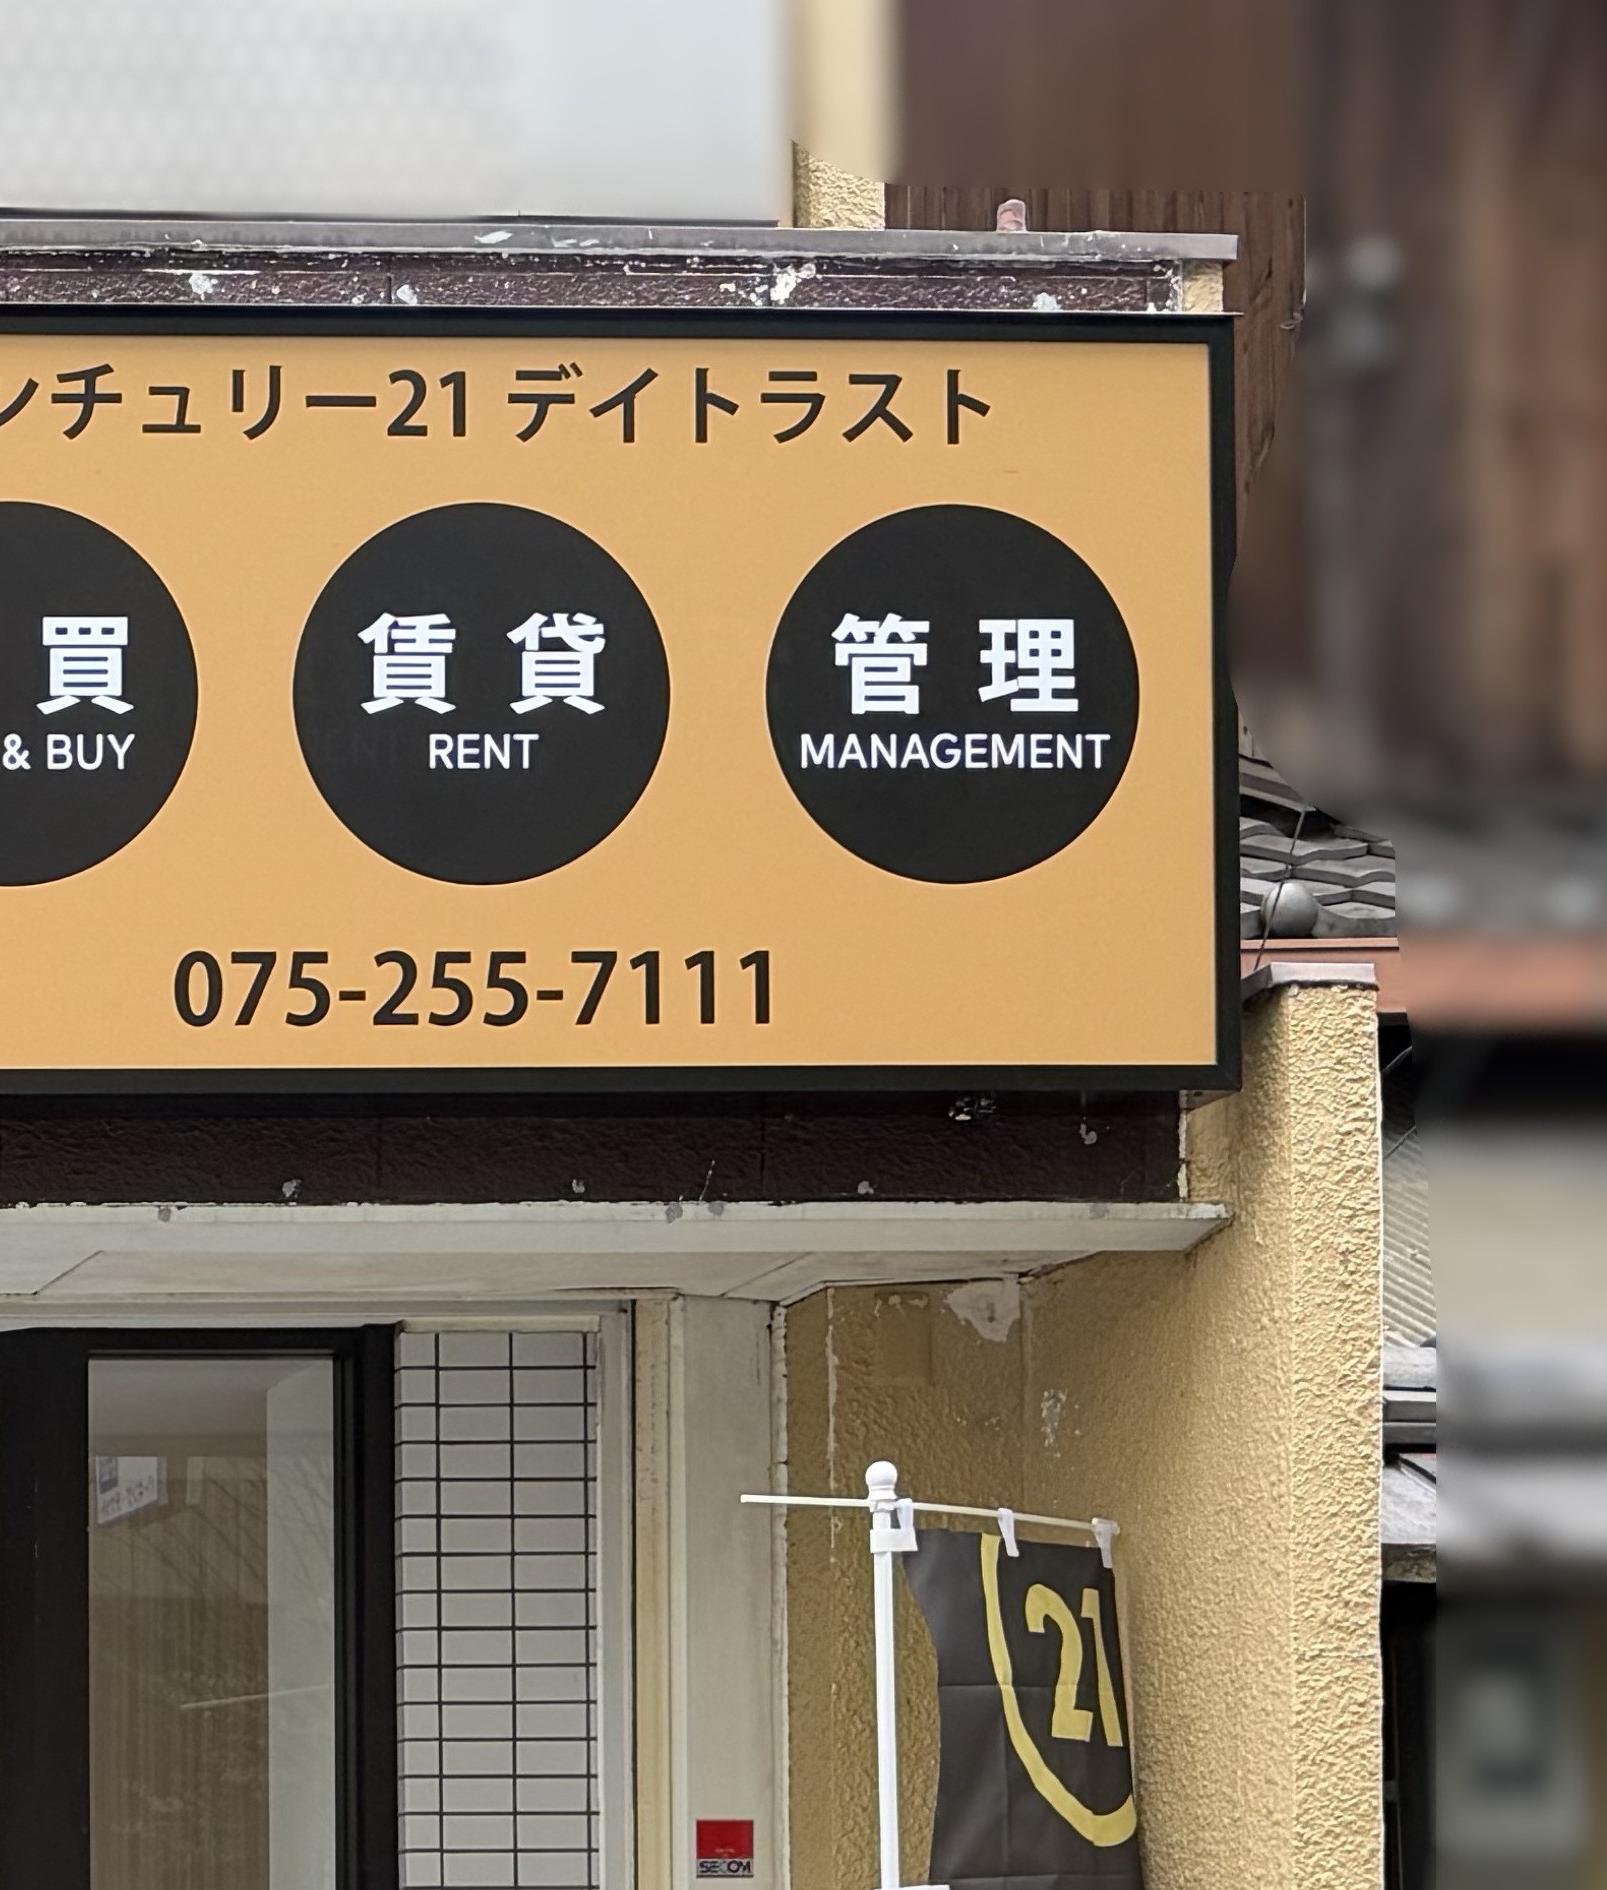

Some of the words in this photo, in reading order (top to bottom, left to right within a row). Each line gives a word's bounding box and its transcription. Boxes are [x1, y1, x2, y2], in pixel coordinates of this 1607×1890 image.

[508, 363, 992, 446] デイトラスト
[358, 613, 607, 716] 賃貸
[832, 613, 1080, 716] 管理
[3, 734, 32, 772] &
[47, 734, 136, 772] BUY
[430, 734, 541, 771] RENT
[801, 733, 1111, 771] MANAGEMENT
[175, 951, 771, 1029] 075-255-7111
[1024, 1582, 1124, 1748] 21
